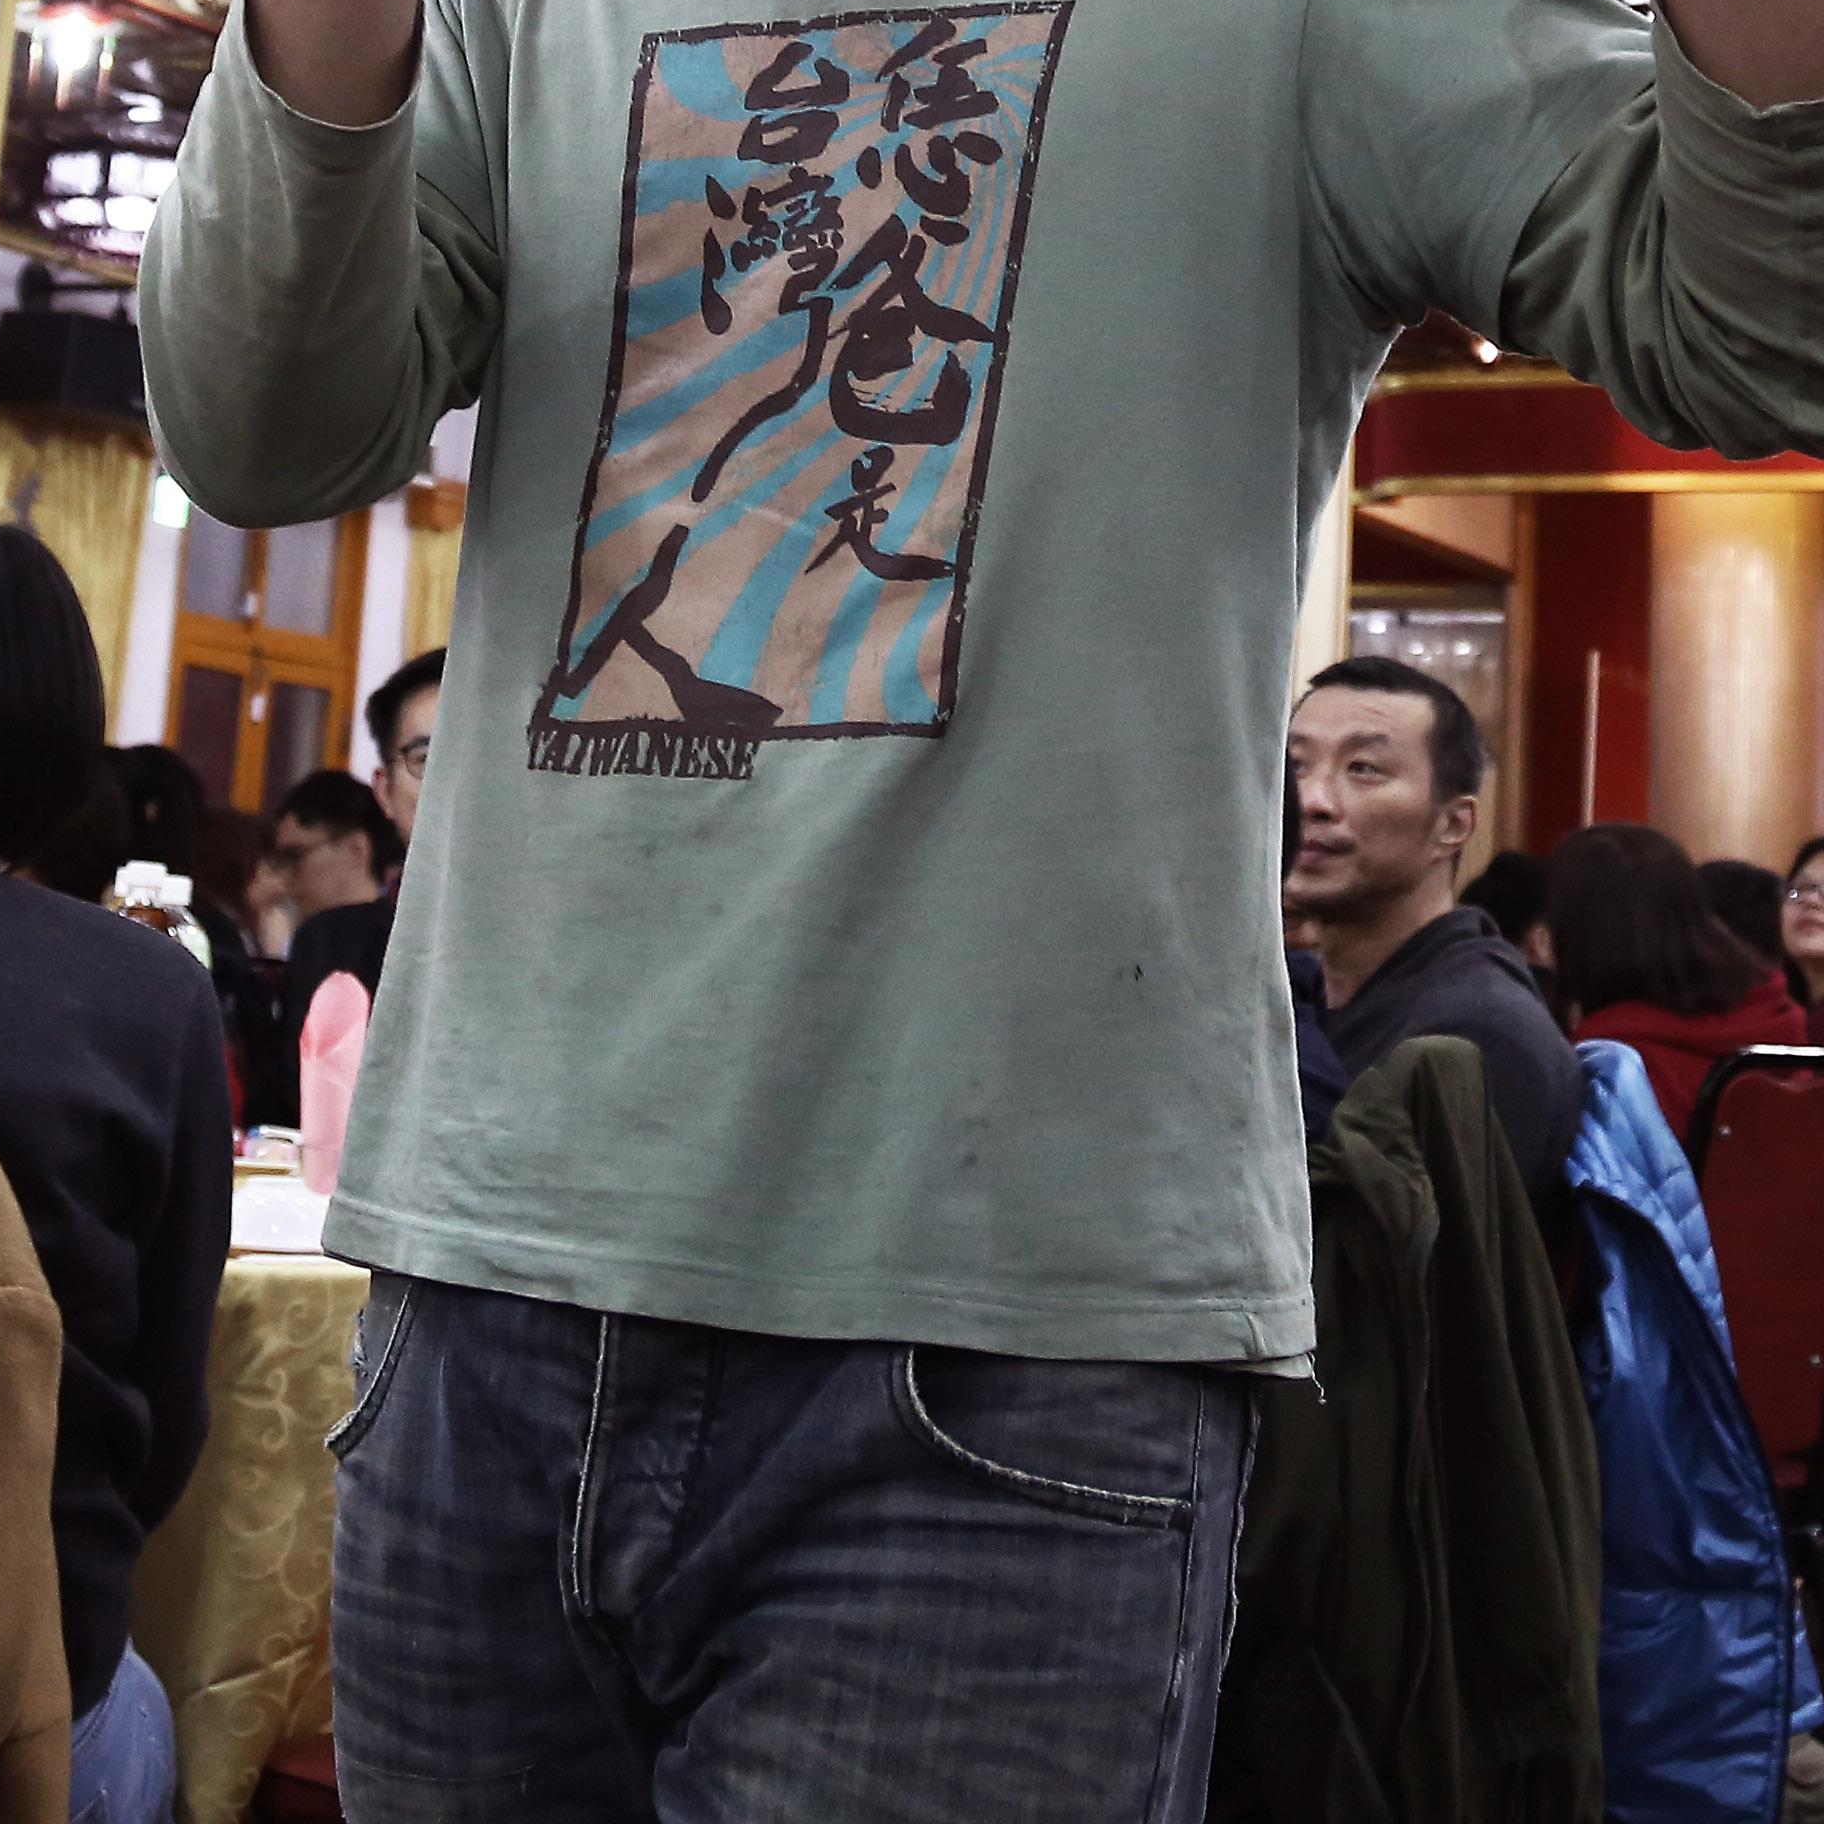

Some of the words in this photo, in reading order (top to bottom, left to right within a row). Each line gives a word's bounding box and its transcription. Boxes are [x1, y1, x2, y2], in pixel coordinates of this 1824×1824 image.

[560, 43, 850, 726] 台灣人
[806, 18, 1000, 580] 恁爸是
[527, 729, 759, 780] TAIWANESE
